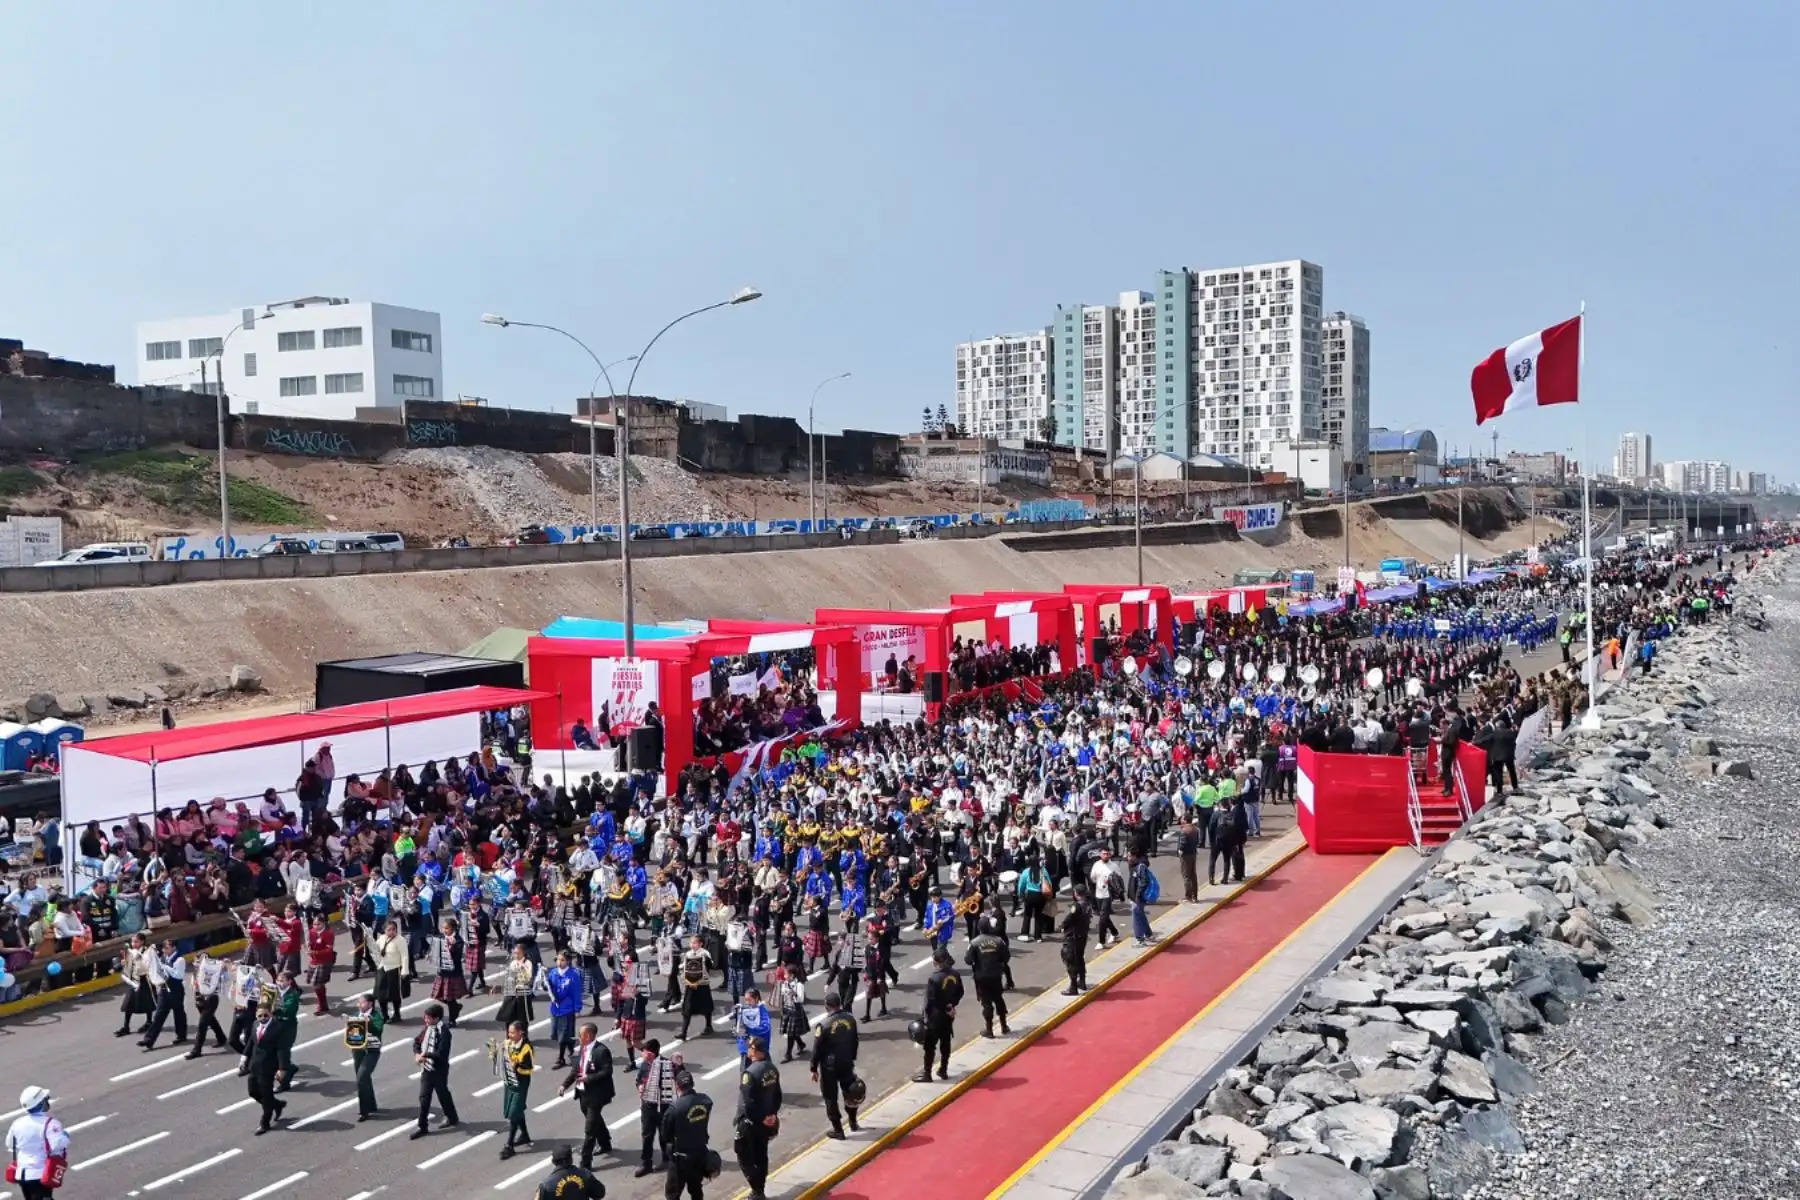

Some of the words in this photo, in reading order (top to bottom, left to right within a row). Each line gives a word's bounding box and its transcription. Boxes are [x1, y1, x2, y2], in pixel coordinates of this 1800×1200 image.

[1247, 507, 1276, 528] CUMPLE
[863, 630, 887, 643] GRAN
[889, 625, 916, 640] DESFILE
[612, 671, 642, 681] FIESTAS
[611, 680, 643, 690] PATRIAS
